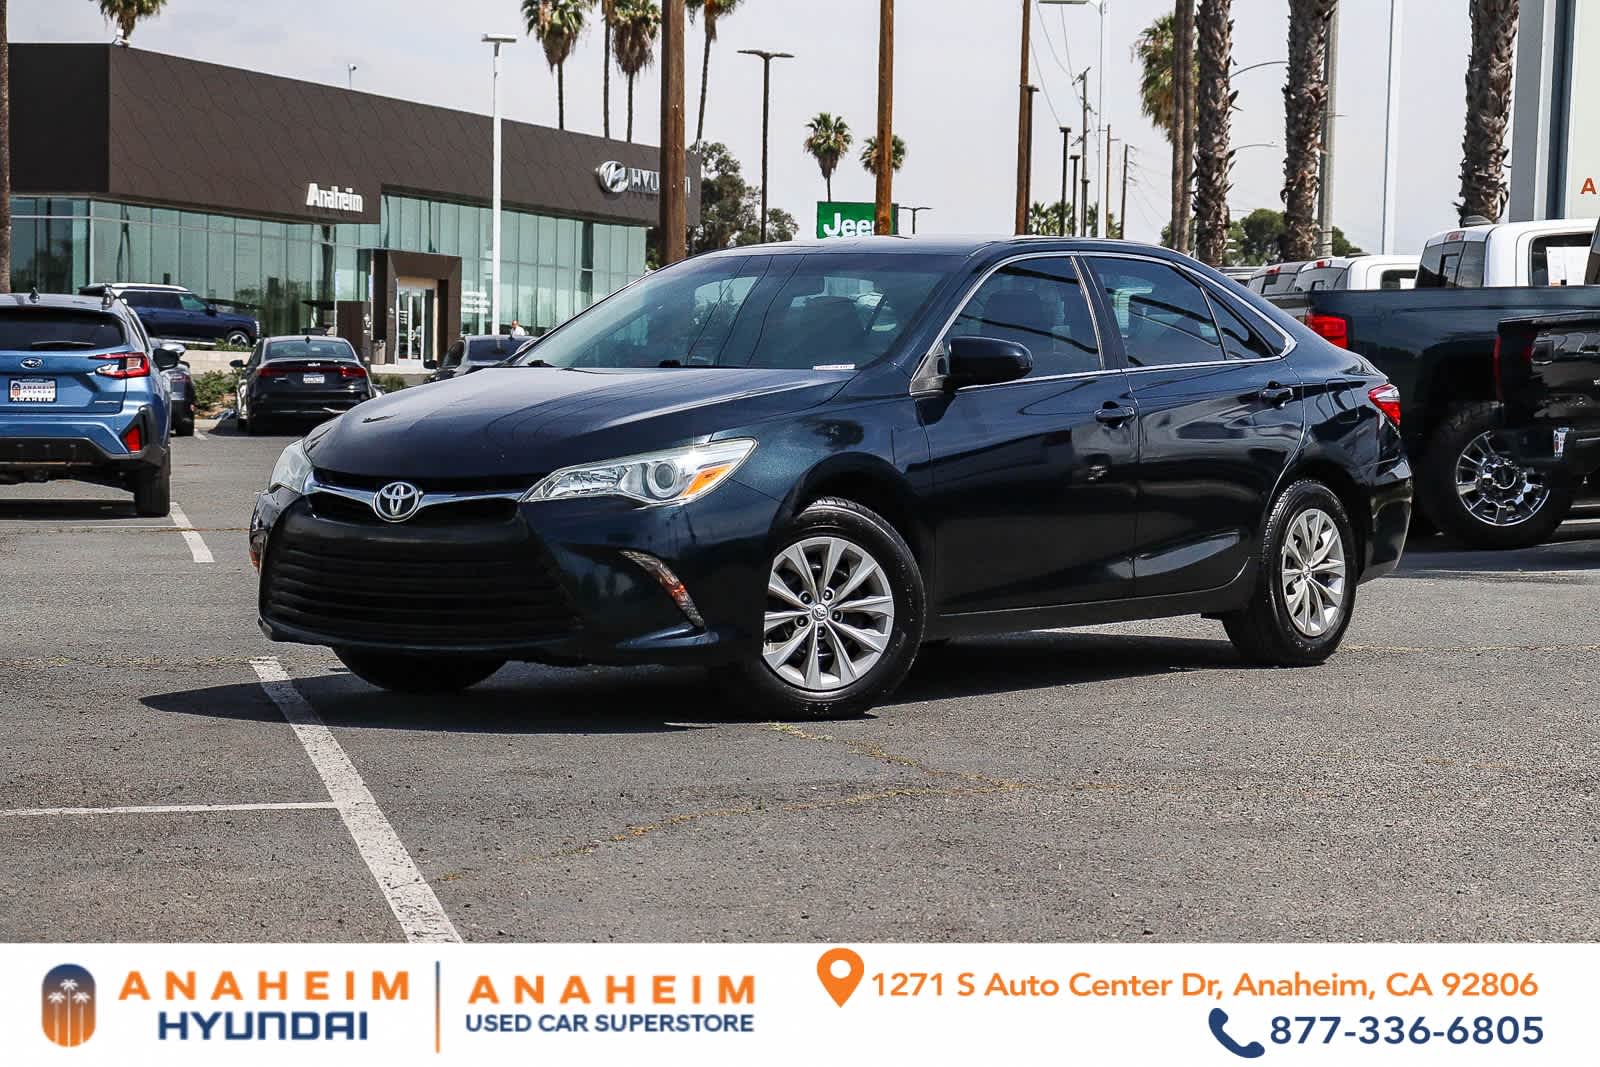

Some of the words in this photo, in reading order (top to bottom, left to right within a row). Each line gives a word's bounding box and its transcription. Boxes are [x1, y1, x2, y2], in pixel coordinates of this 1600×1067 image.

[628, 168, 691, 194] HYUI
[306, 183, 363, 212] Anaheim
[823, 212, 876, 237] Jee
